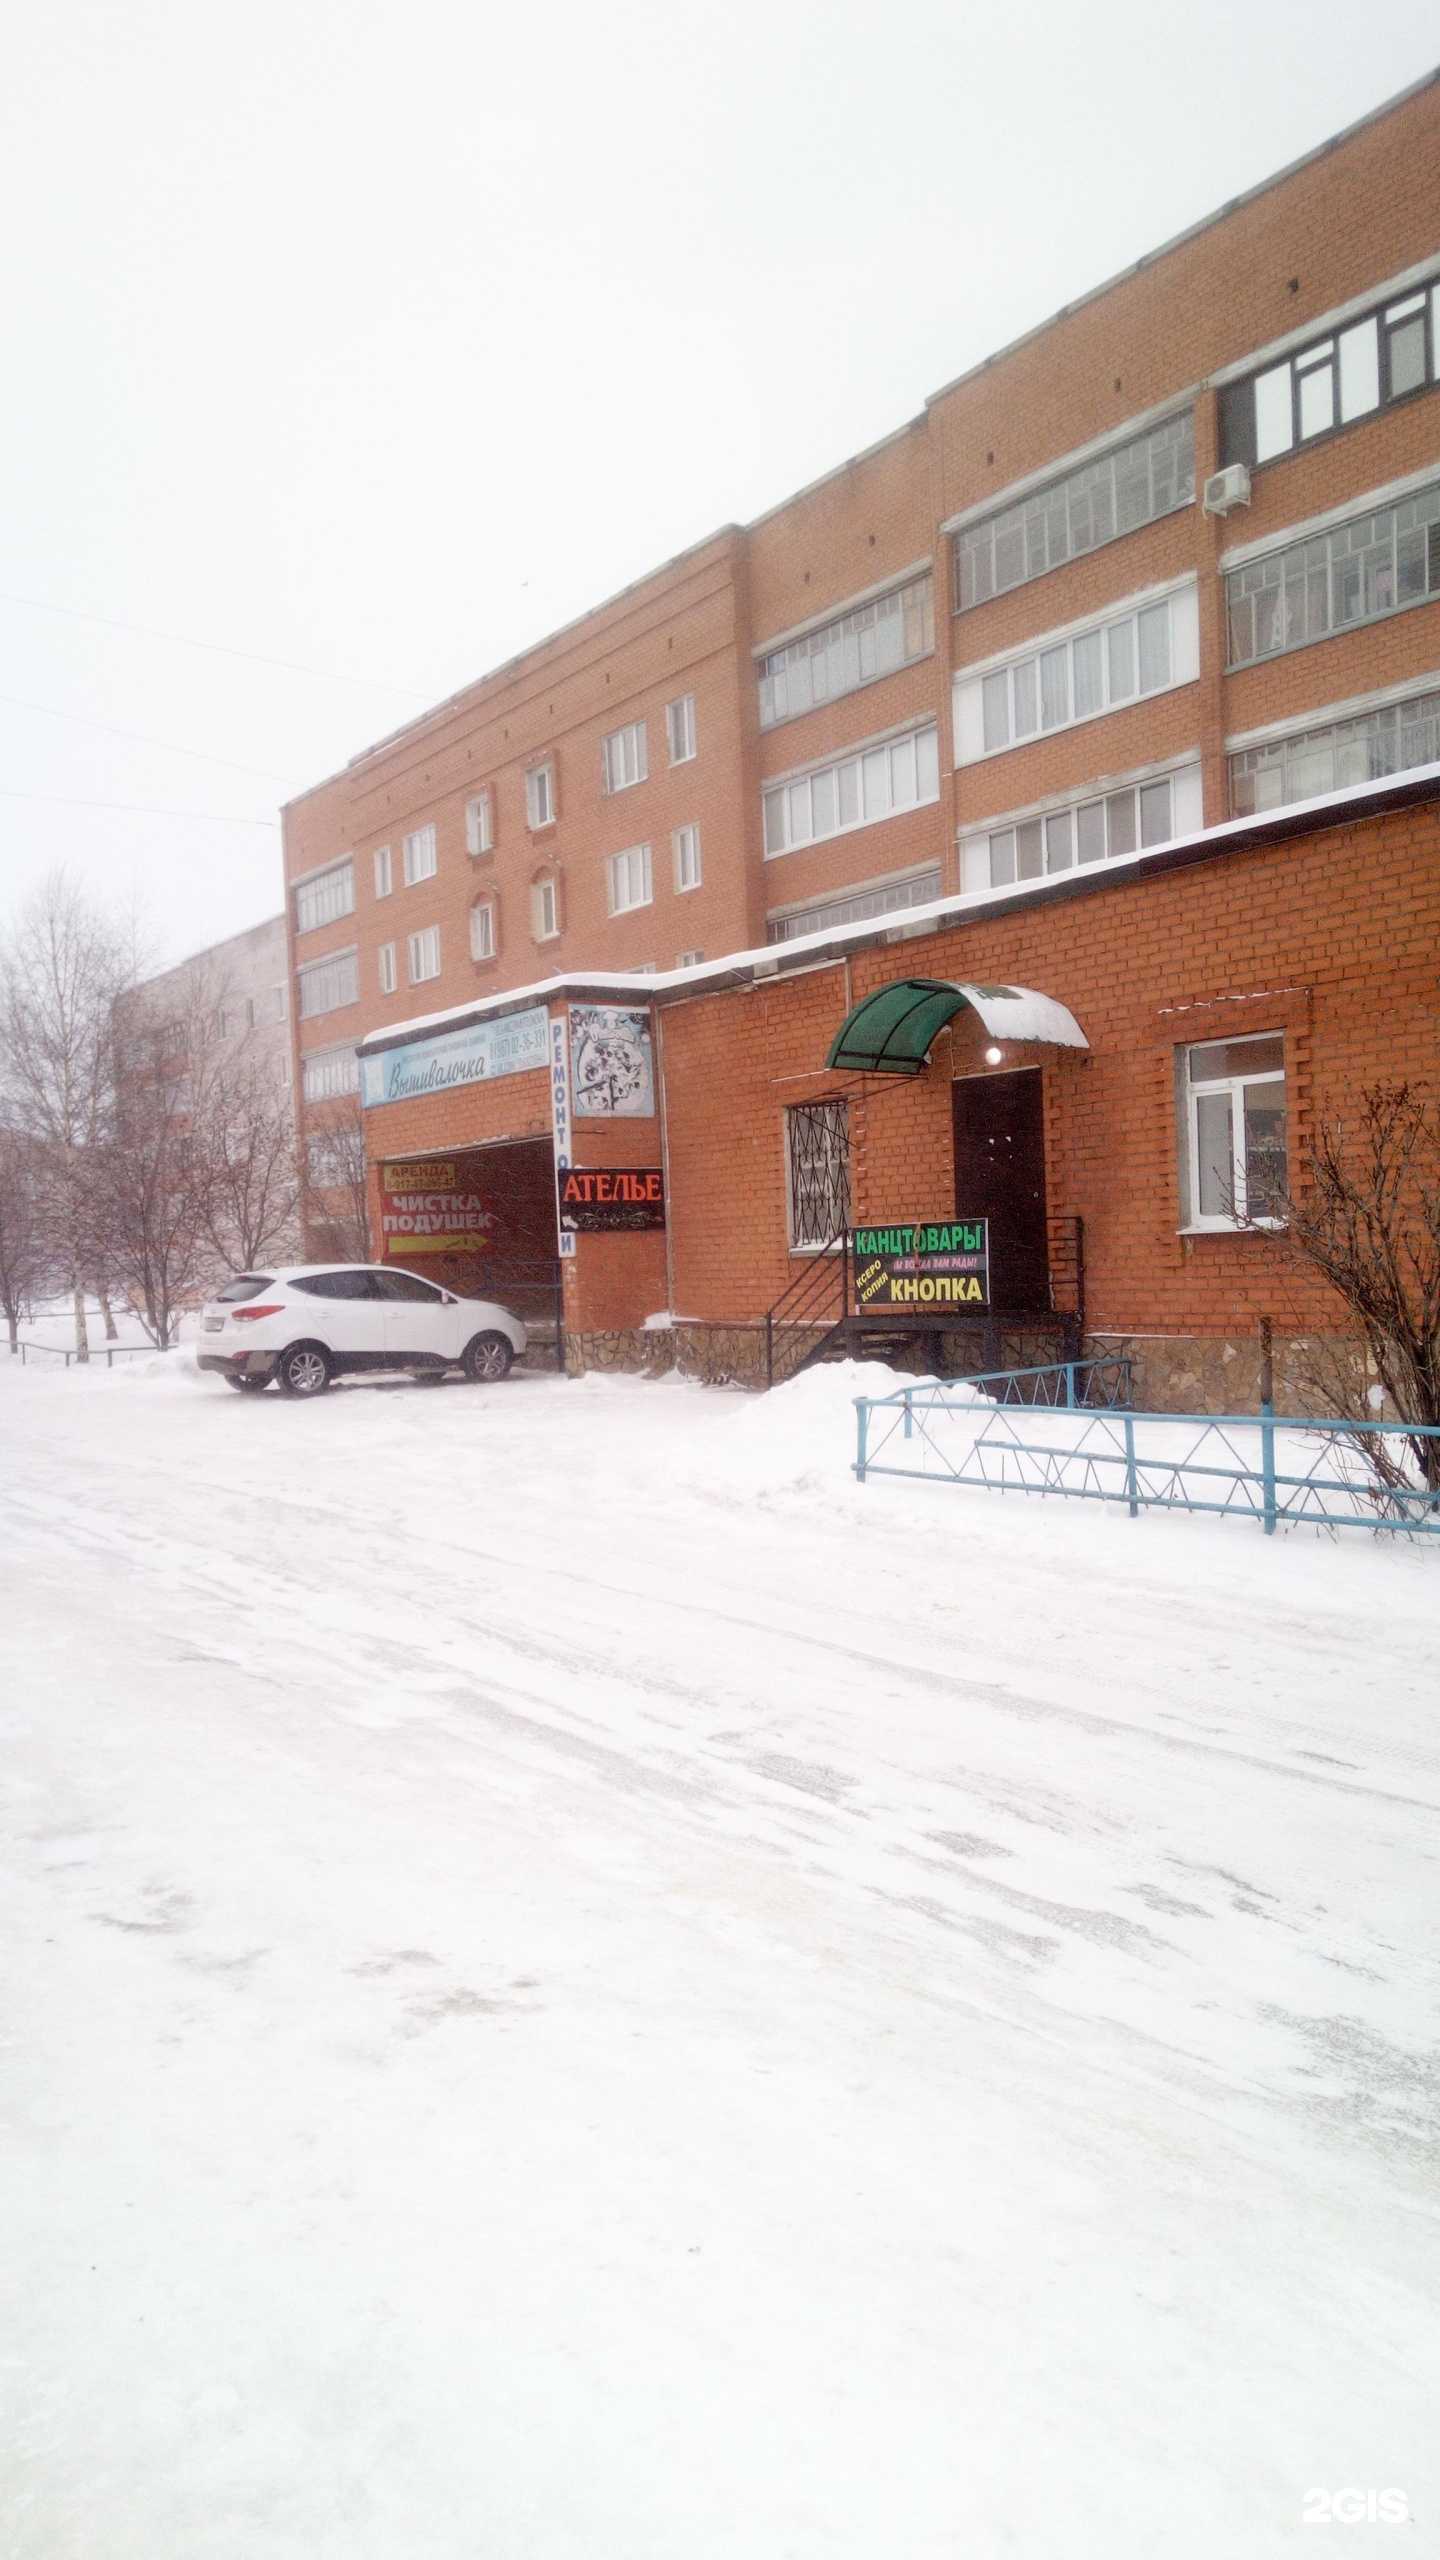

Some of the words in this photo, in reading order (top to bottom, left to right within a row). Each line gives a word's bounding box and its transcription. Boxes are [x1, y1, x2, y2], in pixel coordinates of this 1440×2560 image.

[389, 1055, 486, 1099] Вышивалочка
[553, 1024, 566, 1145] РЕМОНТ
[391, 1166, 450, 1178] АРЕНДА
[563, 1174, 661, 1201] АТЕЛЬЕ
[391, 1195, 481, 1211] ЧИСТКА
[383, 1213, 493, 1234] ПОДУШЕК
[856, 1224, 982, 1256] КАНЦТОВАРЫ
[856, 1259, 882, 1289] КСЕРО
[861, 1272, 889, 1302] КОПИЯ
[890, 1277, 983, 1301] КНОПКА
